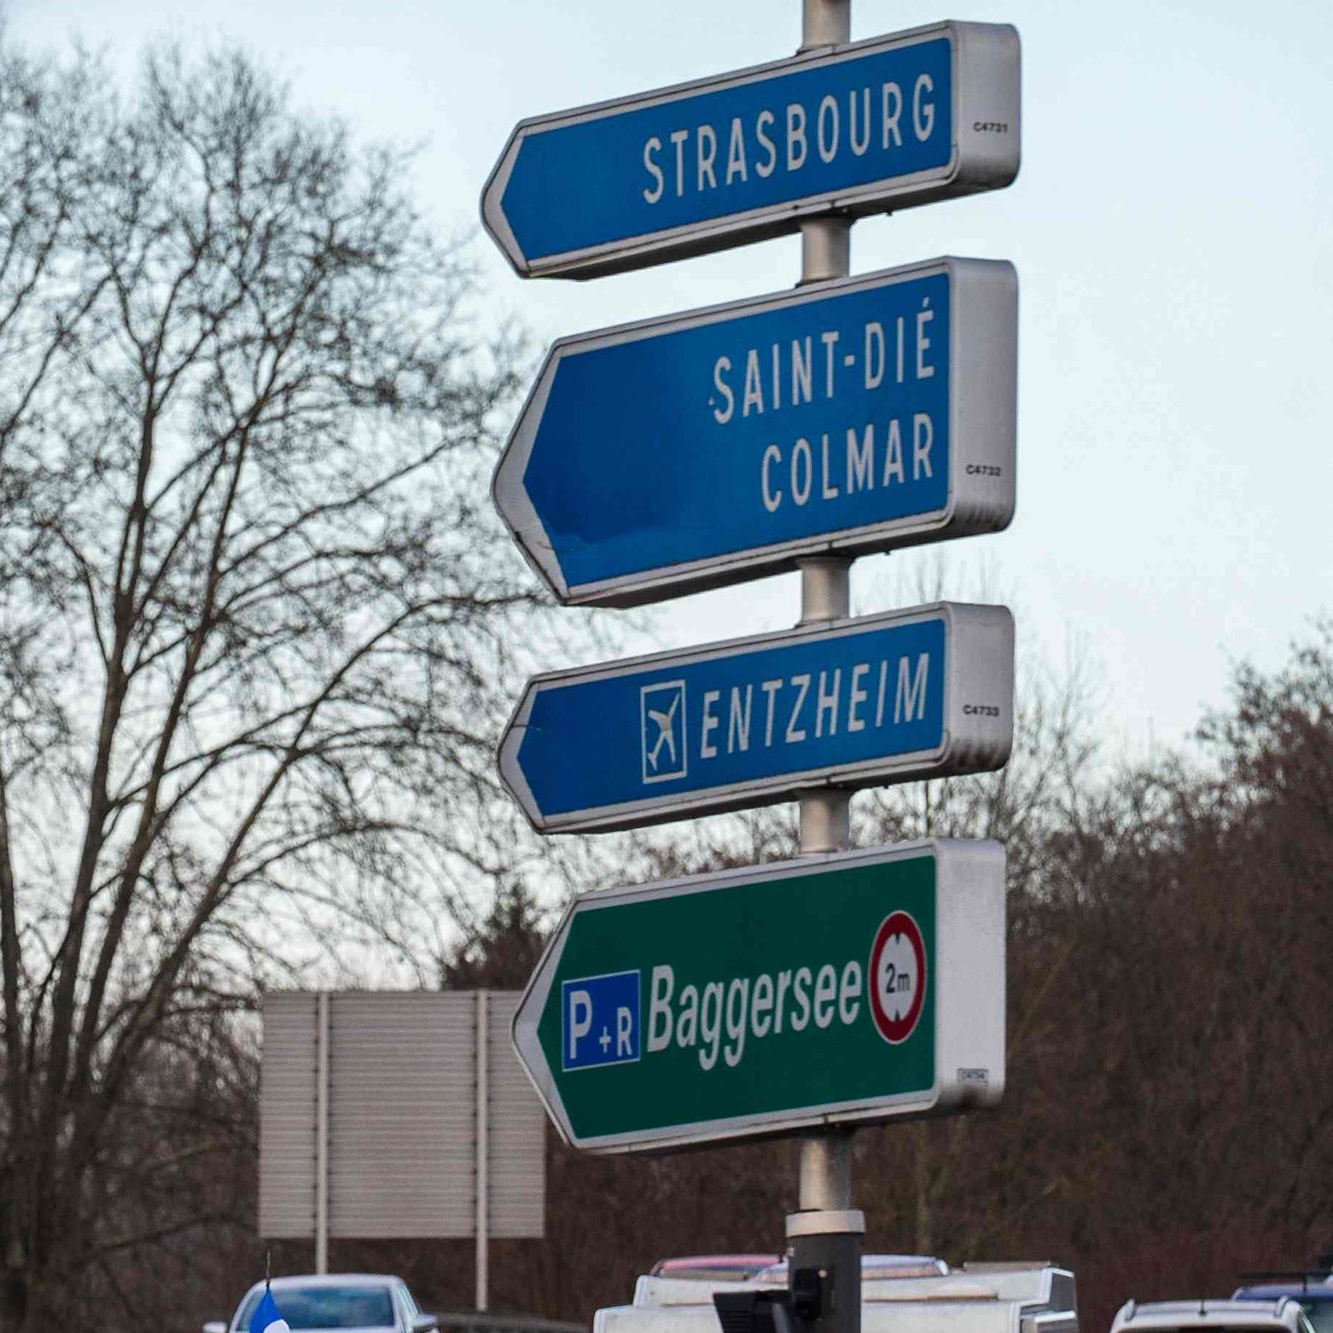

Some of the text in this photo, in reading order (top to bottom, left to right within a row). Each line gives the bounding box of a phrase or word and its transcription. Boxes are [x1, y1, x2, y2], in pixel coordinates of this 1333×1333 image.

[643, 74, 935, 204] STRASBOURG
[713, 298, 935, 424] SAINT-DIÉ
[762, 414, 933, 512] COLMAR
[700, 652, 929, 759] ENTZHEIM
[647, 961, 862, 1071] Baggersee
